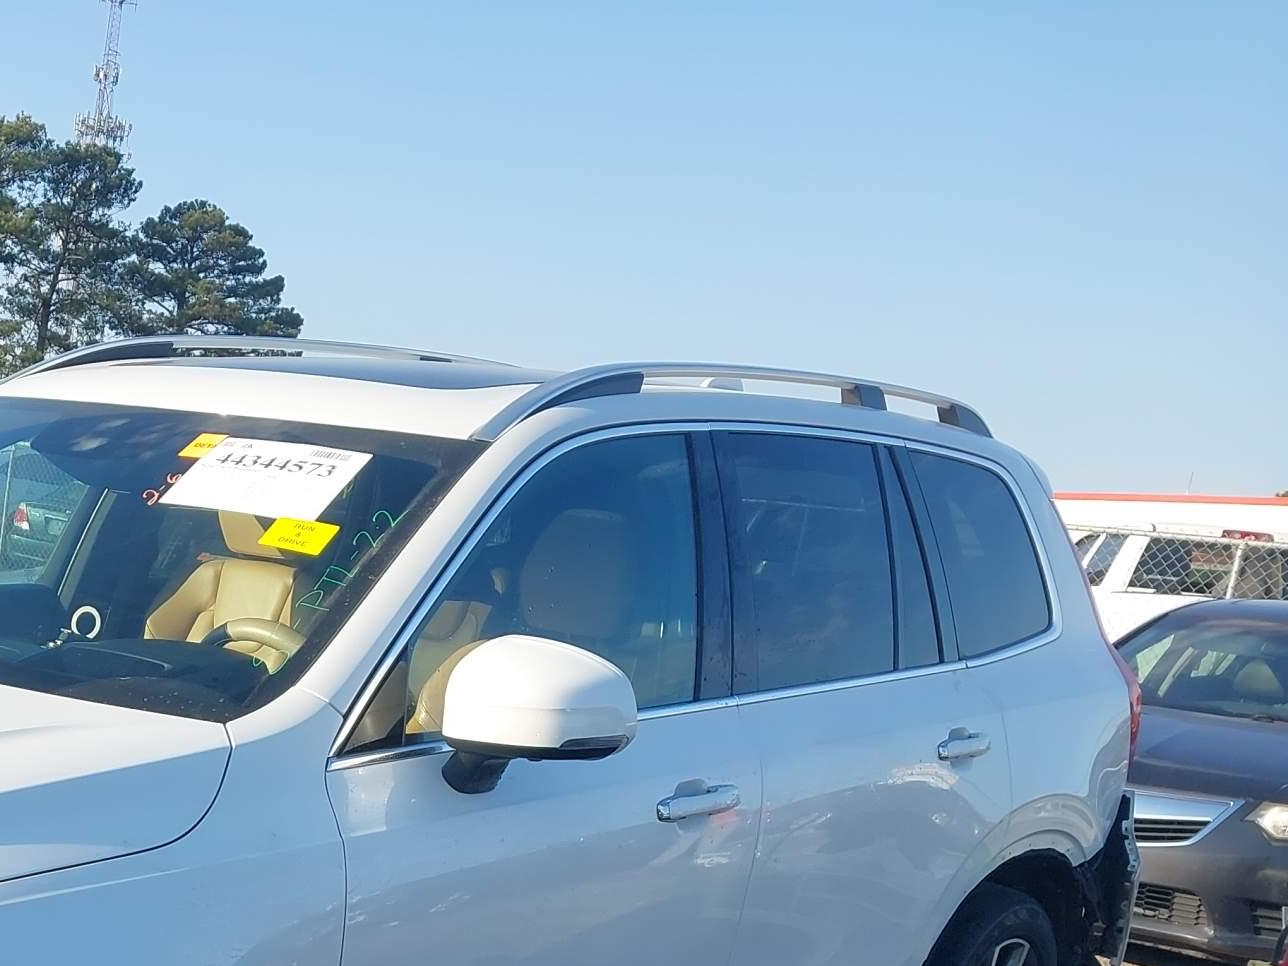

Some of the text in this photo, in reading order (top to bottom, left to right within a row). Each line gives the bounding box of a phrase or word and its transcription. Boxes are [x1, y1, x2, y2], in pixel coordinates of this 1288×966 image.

[215, 452, 337, 478] 44344573
[294, 522, 316, 532] RUN
[278, 536, 311, 547] DRIVE
